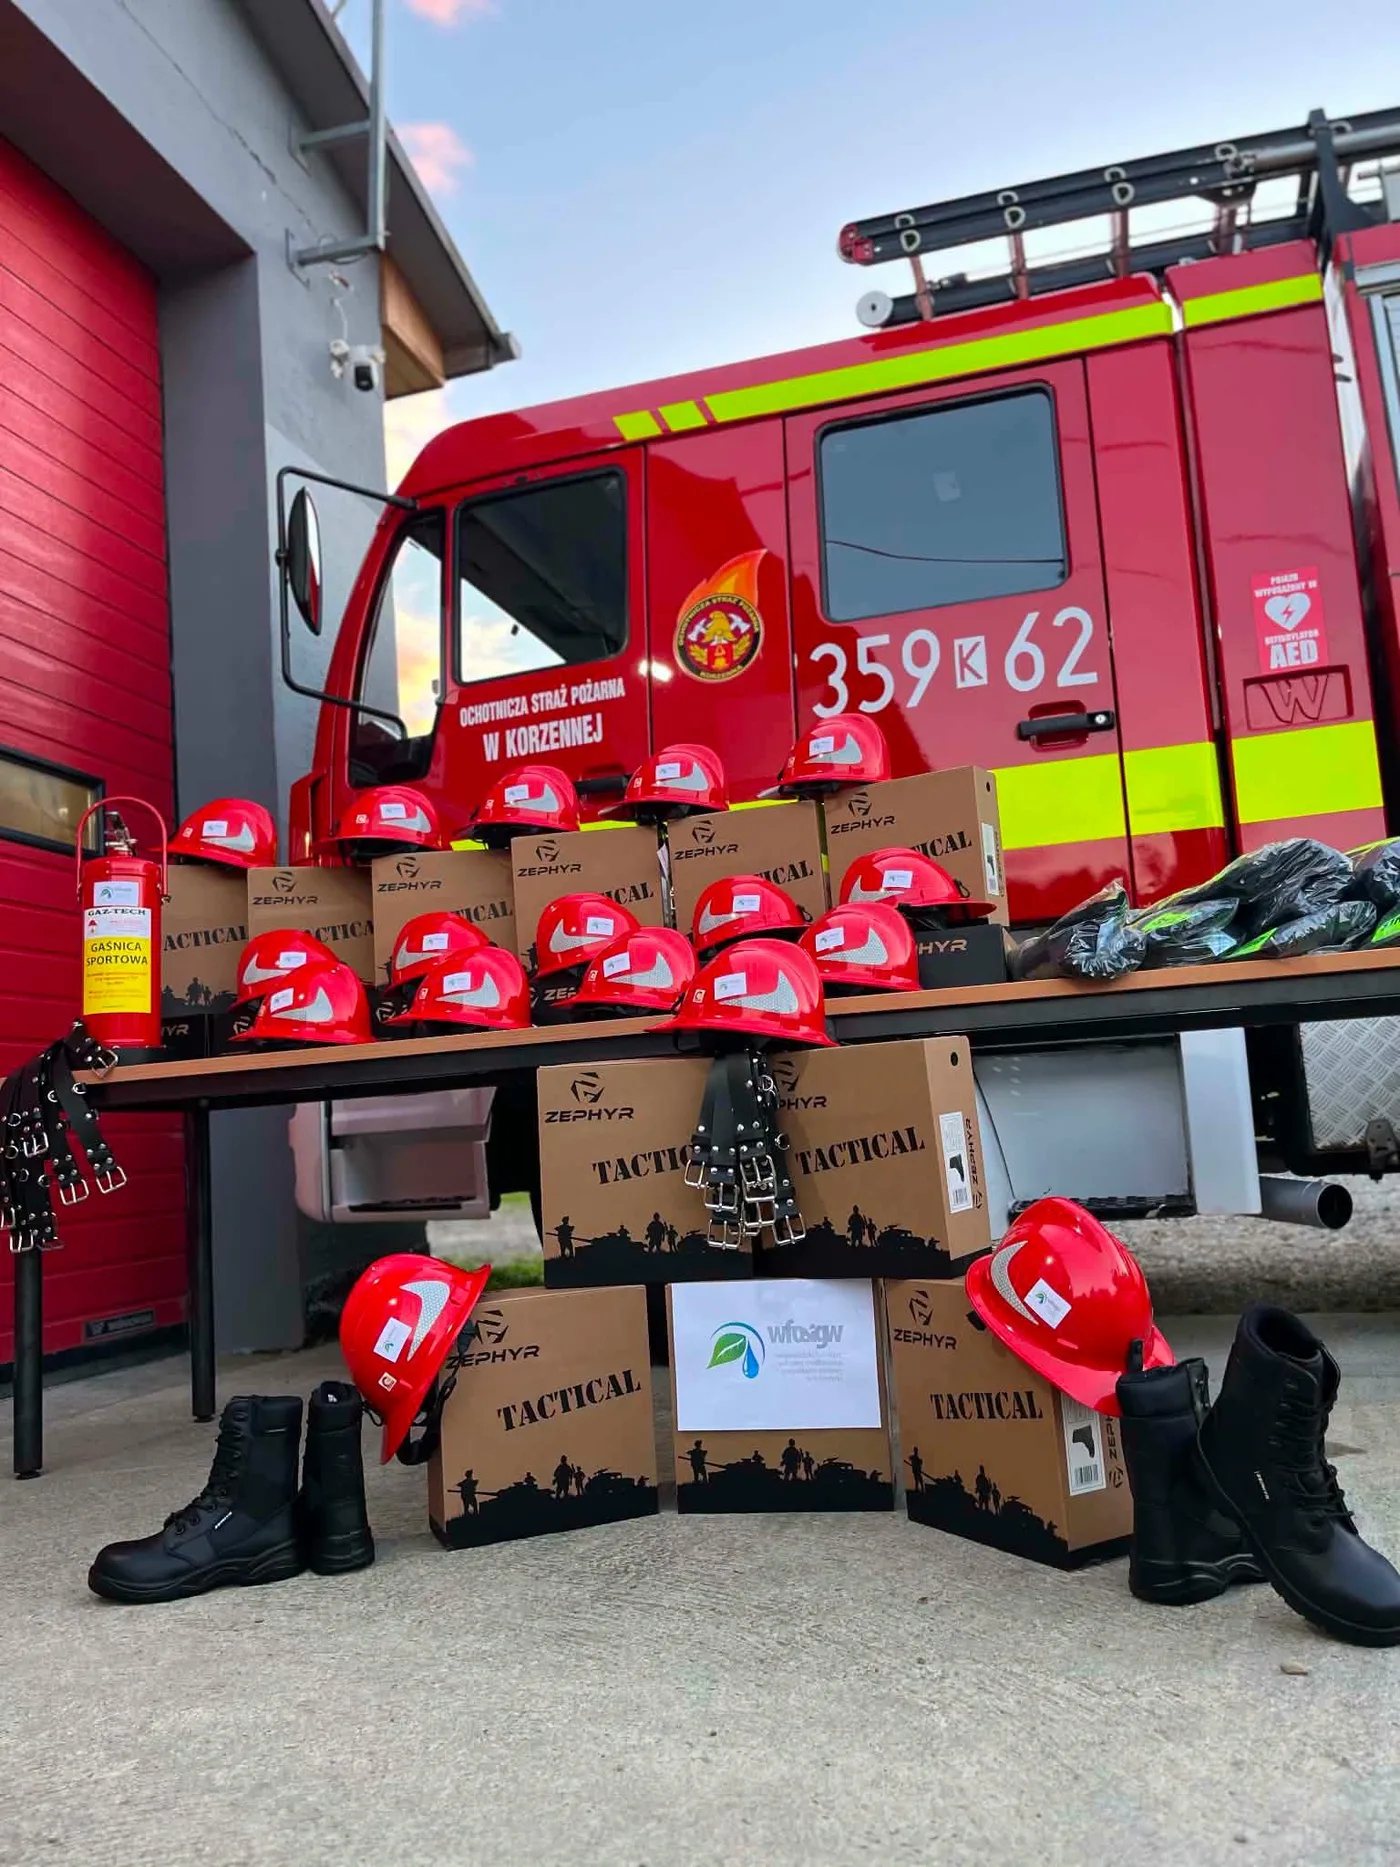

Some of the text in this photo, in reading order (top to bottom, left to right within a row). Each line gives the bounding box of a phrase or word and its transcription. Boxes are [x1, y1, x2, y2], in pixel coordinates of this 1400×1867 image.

[809, 606, 1098, 718] 359 K 62
[1270, 639, 1319, 670] AED
[460, 677, 626, 727] OCHOTNICZA STRAŻ POŻARNA
[483, 712, 604, 762] W KORZENNEJ
[830, 815, 896, 835] ZEPHYR
[674, 843, 739, 860] ZEPHYR
[908, 831, 972, 858] ICAL
[518, 863, 583, 877] ZEPHYR
[752, 860, 813, 884] ICAL
[377, 880, 442, 893] ZEPHYR
[600, 882, 654, 904] ICAL
[252, 896, 319, 905] ZEPHYR
[163, 925, 249, 951] ACTICAL
[303, 920, 374, 942] CTICA
[91, 940, 142, 953] GAŚNICA
[917, 939, 967, 954] HYR
[86, 955, 148, 967] SPORTOWA
[543, 987, 577, 1001] ZEP
[778, 1096, 827, 1110] PHYR
[545, 1107, 634, 1123] ZEPHYR
[795, 1126, 925, 1176] TACTICAL
[592, 1144, 694, 1184] TACTIC
[894, 1329, 957, 1349] ZEPHYR
[445, 1345, 541, 1370] ZEPHYR
[497, 1369, 641, 1431] TACTICAL
[930, 1391, 1043, 1419] TACTICAL
